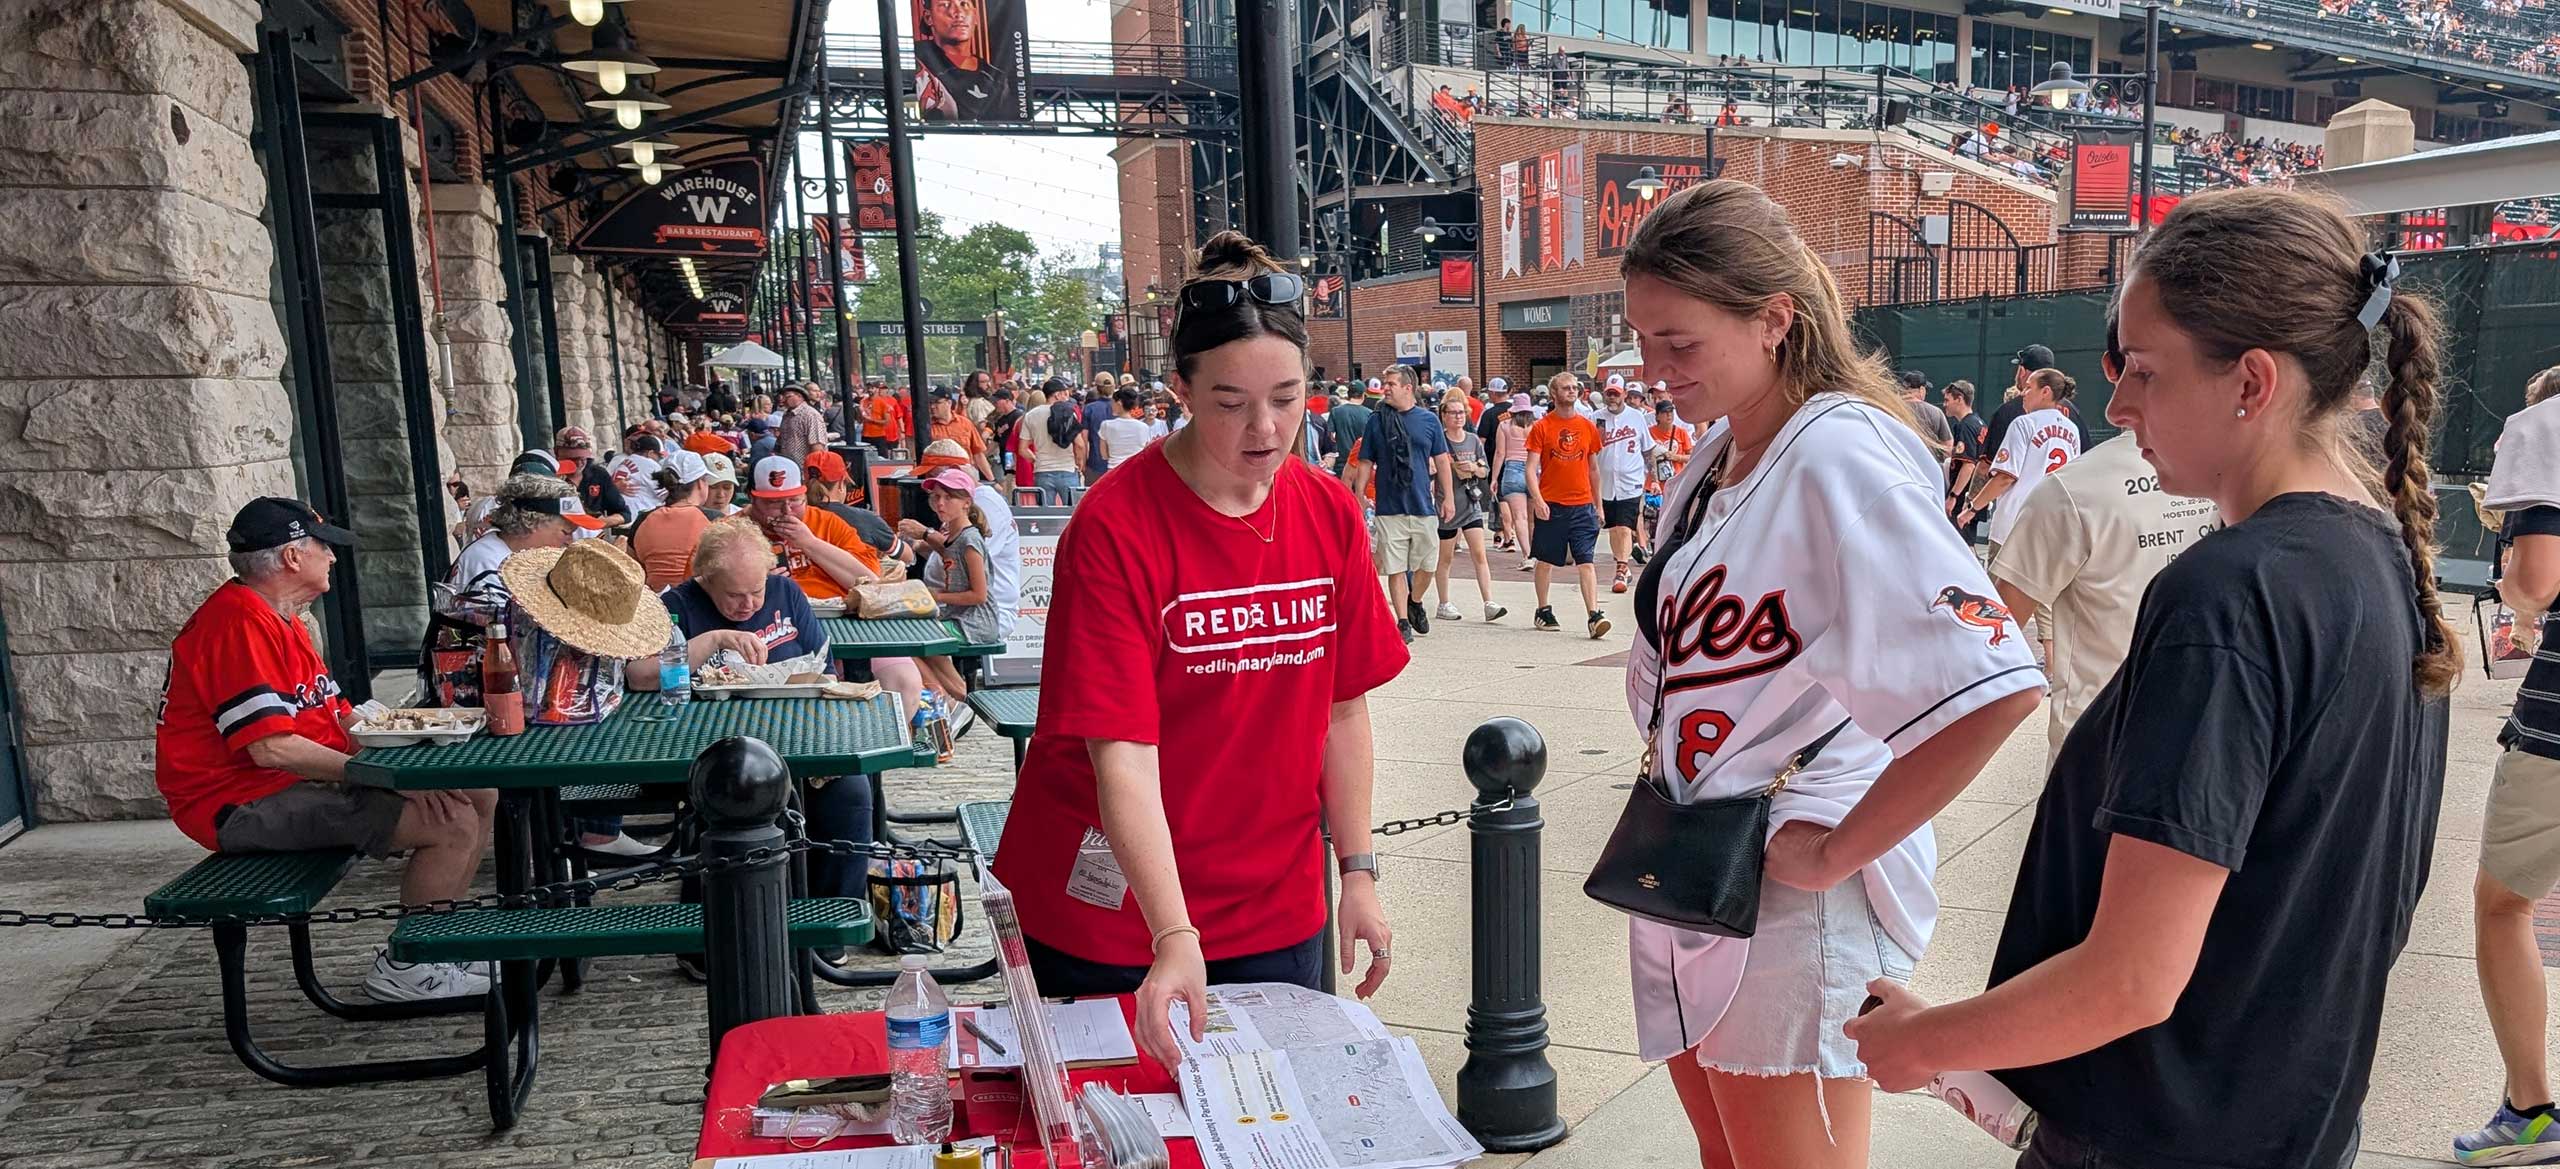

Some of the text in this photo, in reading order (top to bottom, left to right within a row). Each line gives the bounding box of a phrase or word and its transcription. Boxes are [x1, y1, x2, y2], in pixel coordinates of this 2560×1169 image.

[1013, 31, 1028, 118] SAMUEL BASALLO
[1544, 159, 1558, 193] AL
[660, 176, 756, 206] WAREHOUSE
[687, 195, 730, 224] W
[2074, 213, 2088, 221] FLY
[666, 226, 754, 239] BAR & RESTAURANT
[1523, 305, 1552, 324] WOMEN
[880, 324, 966, 334] EUT STREET
[1434, 343, 1463, 355] Corona
[1627, 439, 1636, 454] 2
[2045, 447, 2068, 476] 2
[2124, 475, 2161, 496] 202
[2162, 509, 2197, 520] HOSTED
[2198, 507, 2210, 516] BY
[2137, 529, 2185, 549] BRENT
[1019, 547, 1033, 556] CK
[1184, 594, 1328, 638] RED LINE
[1675, 708, 1737, 784] 8
